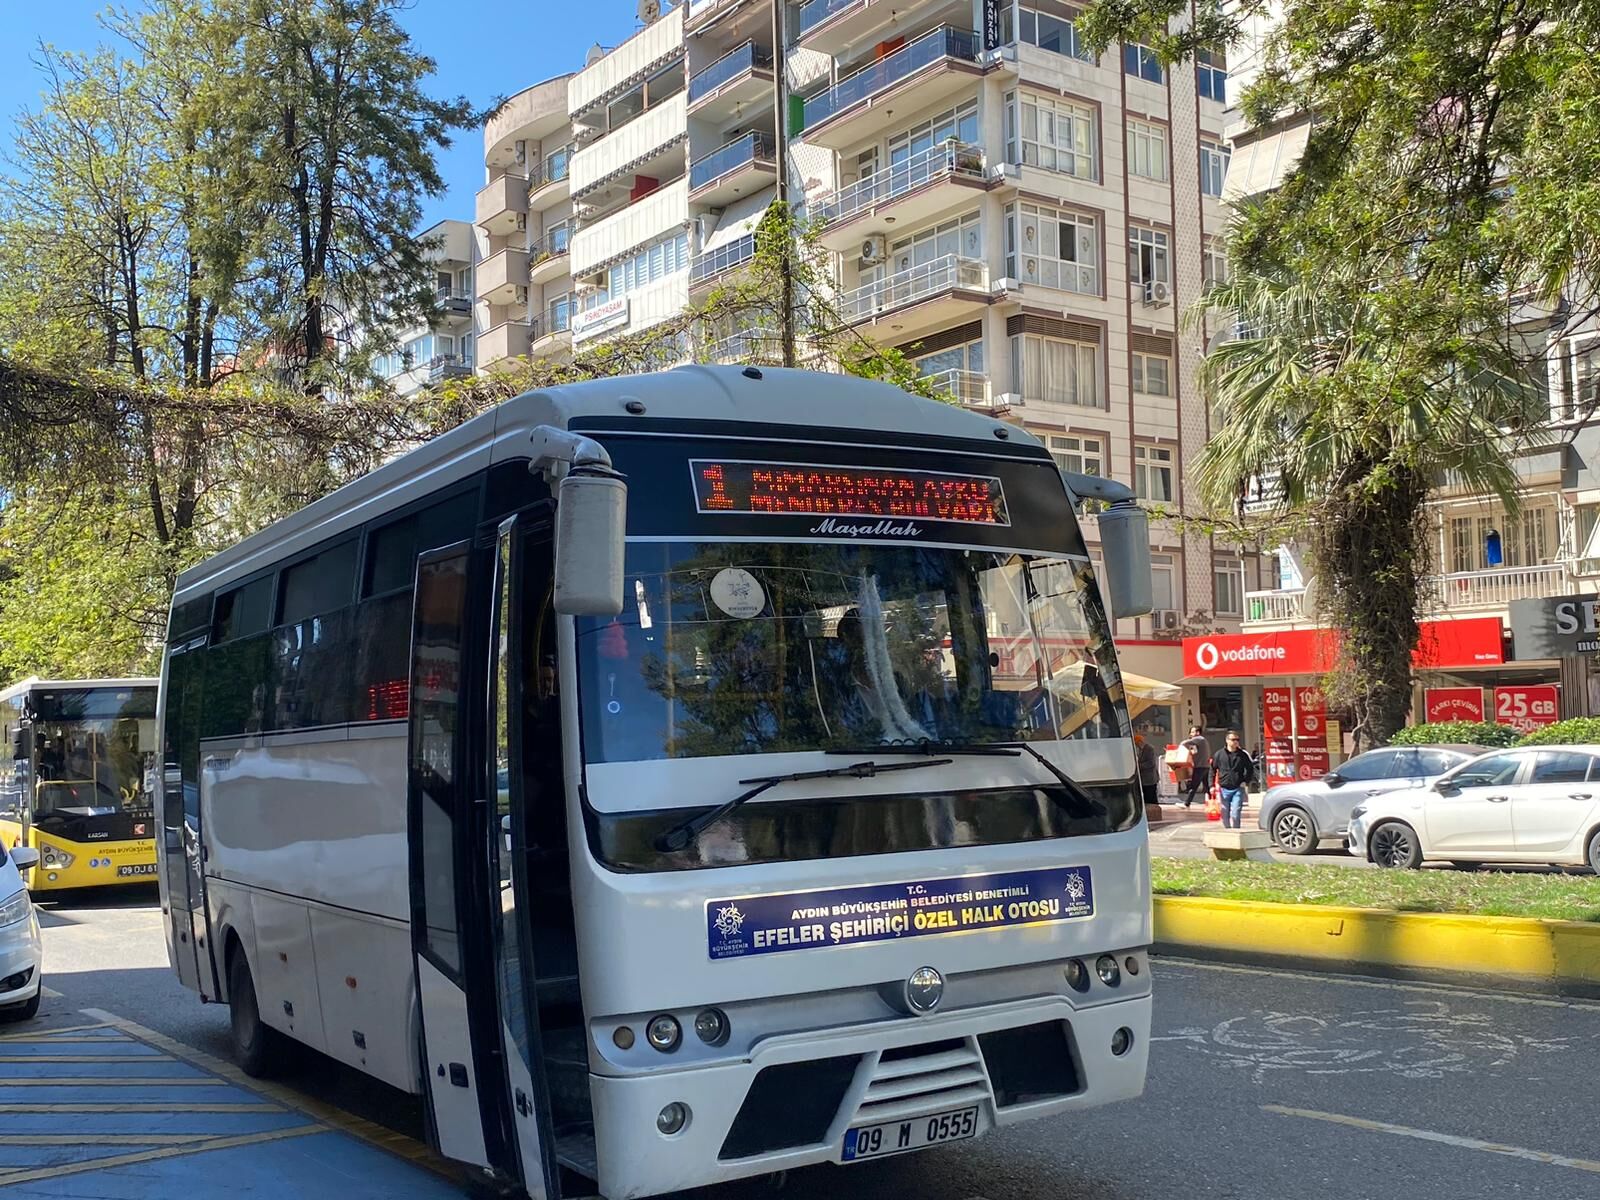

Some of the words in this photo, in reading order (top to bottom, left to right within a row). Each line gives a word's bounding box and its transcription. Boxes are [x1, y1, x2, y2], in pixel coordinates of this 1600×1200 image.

[703, 464, 734, 508] 1
[810, 518, 923, 537] Maşallah
[1221, 644, 1286, 662] vodafone
[1266, 692, 1279, 704] 20
[1498, 692, 1528, 718] 25
[1531, 700, 1555, 714] GB
[791, 906, 829, 920] AYDIN
[832, 896, 908, 916] BÜYÜKŞEHİR
[910, 889, 973, 908] BELEDİYESİ
[975, 886, 1029, 900] DENETİMLİ
[906, 885, 928, 895] T.C.
[753, 924, 825, 948] EFELER
[830, 912, 909, 944] ŞEHİRİÇİ
[914, 908, 958, 930] ÖZEL
[962, 905, 1005, 925] HALK
[1008, 898, 1060, 919] OTOSU
[857, 1128, 882, 1154] 09
[898, 1123, 911, 1148] M
[927, 1111, 974, 1141] 0555
